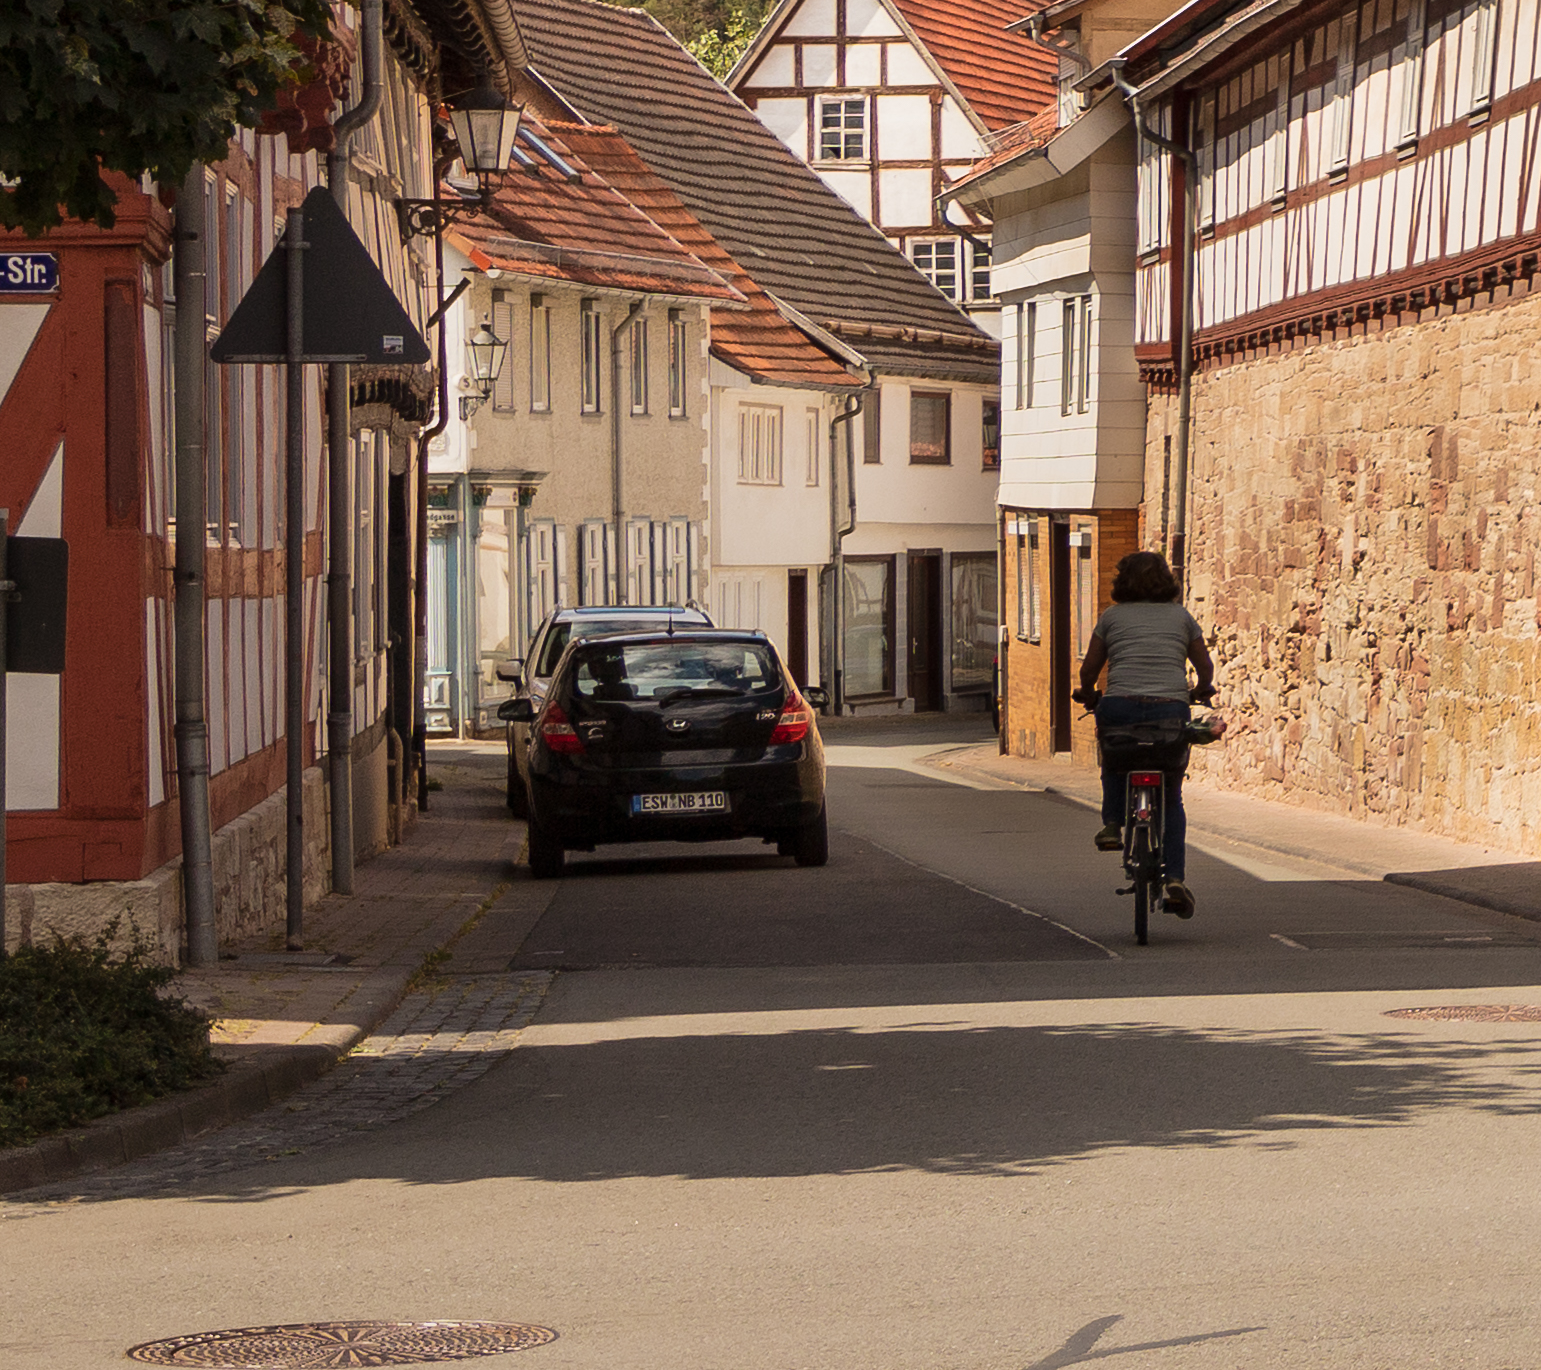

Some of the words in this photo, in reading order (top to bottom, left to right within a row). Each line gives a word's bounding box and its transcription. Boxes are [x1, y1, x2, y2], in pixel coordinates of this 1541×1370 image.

[642, 793, 670, 810] ESW
[678, 792, 696, 808] NB
[699, 791, 724, 808] 110
